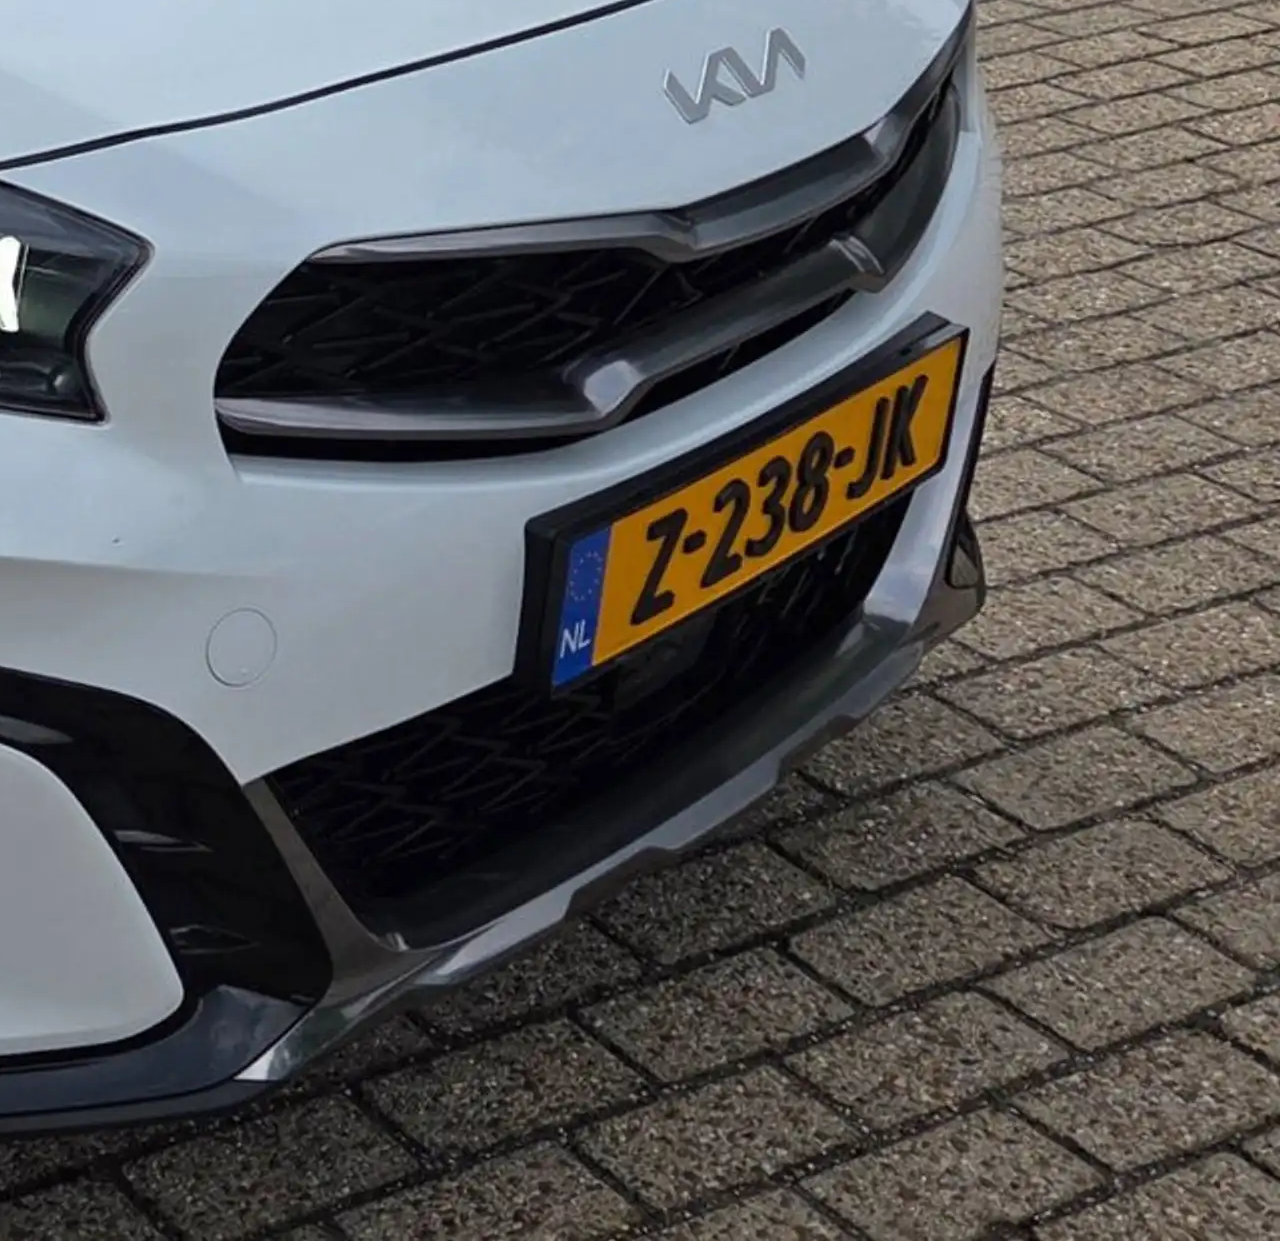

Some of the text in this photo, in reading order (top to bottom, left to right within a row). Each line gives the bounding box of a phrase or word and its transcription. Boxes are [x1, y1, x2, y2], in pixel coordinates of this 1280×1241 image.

[664, 27, 806, 124] KIA
[630, 374, 928, 626] Z-238-JK
[560, 624, 590, 656] NL
